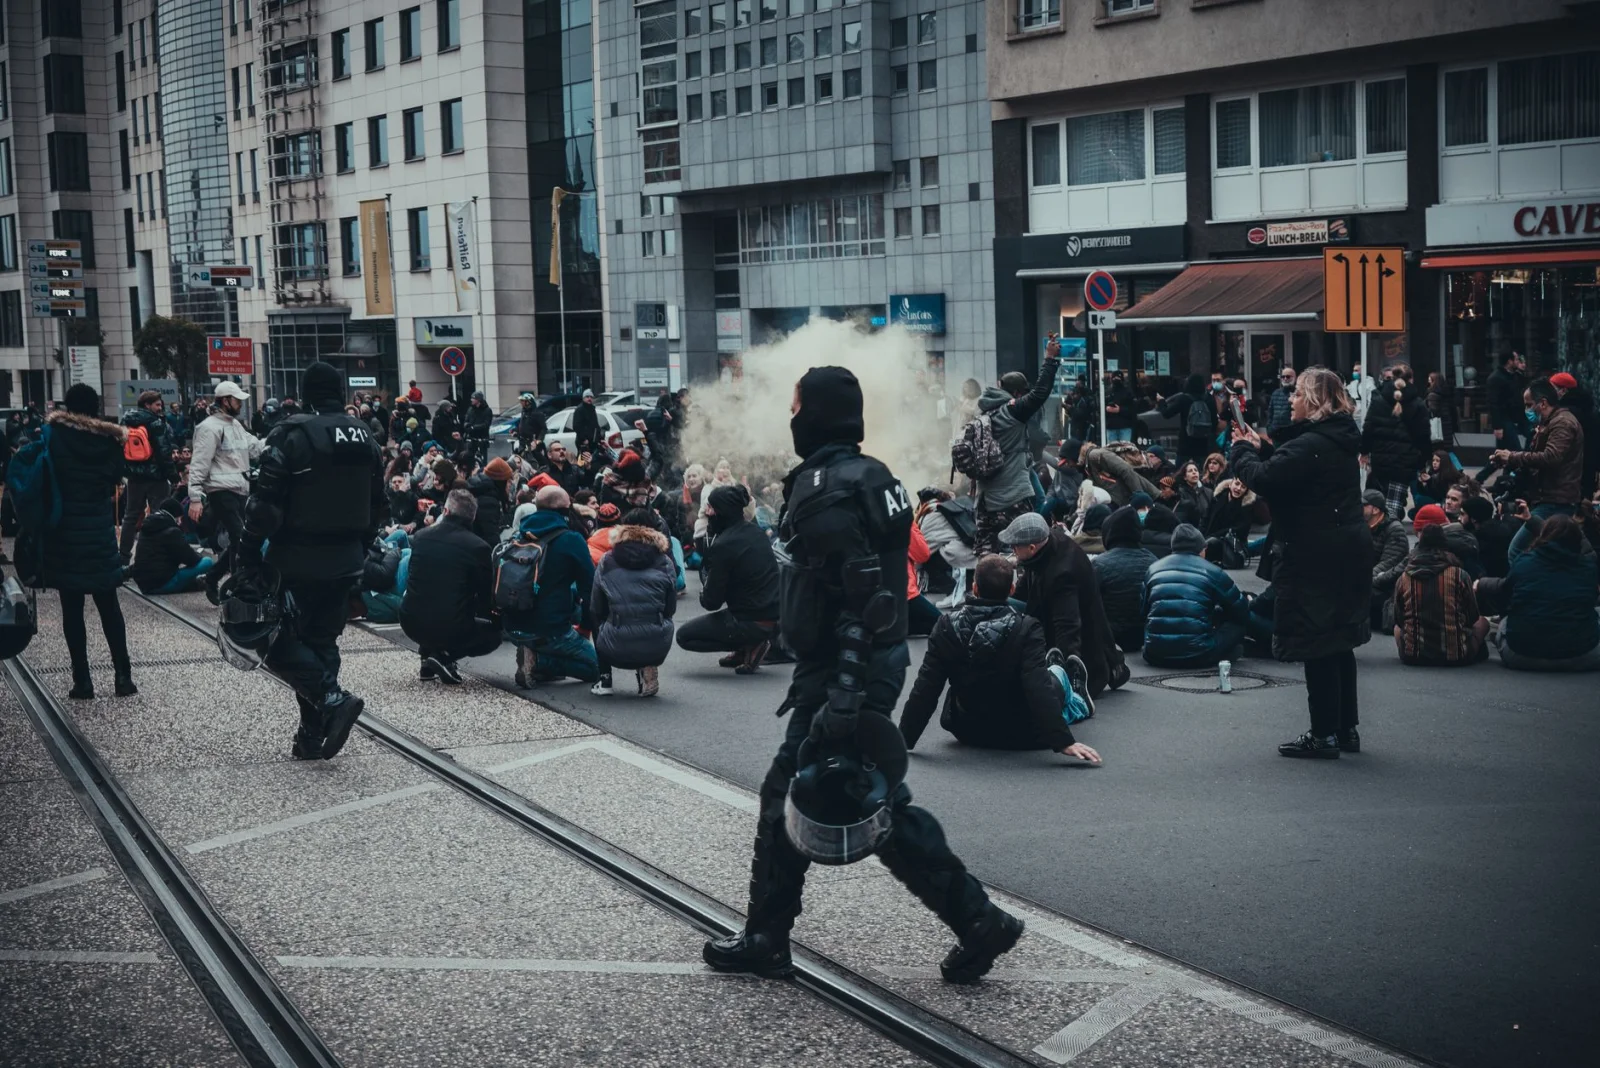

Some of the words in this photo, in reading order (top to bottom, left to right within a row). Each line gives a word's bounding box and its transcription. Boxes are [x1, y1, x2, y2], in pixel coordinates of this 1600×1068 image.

[1269, 232, 1327, 245] LUNCH-BREAK
[335, 426, 349, 443] A
[884, 488, 901, 517] A
